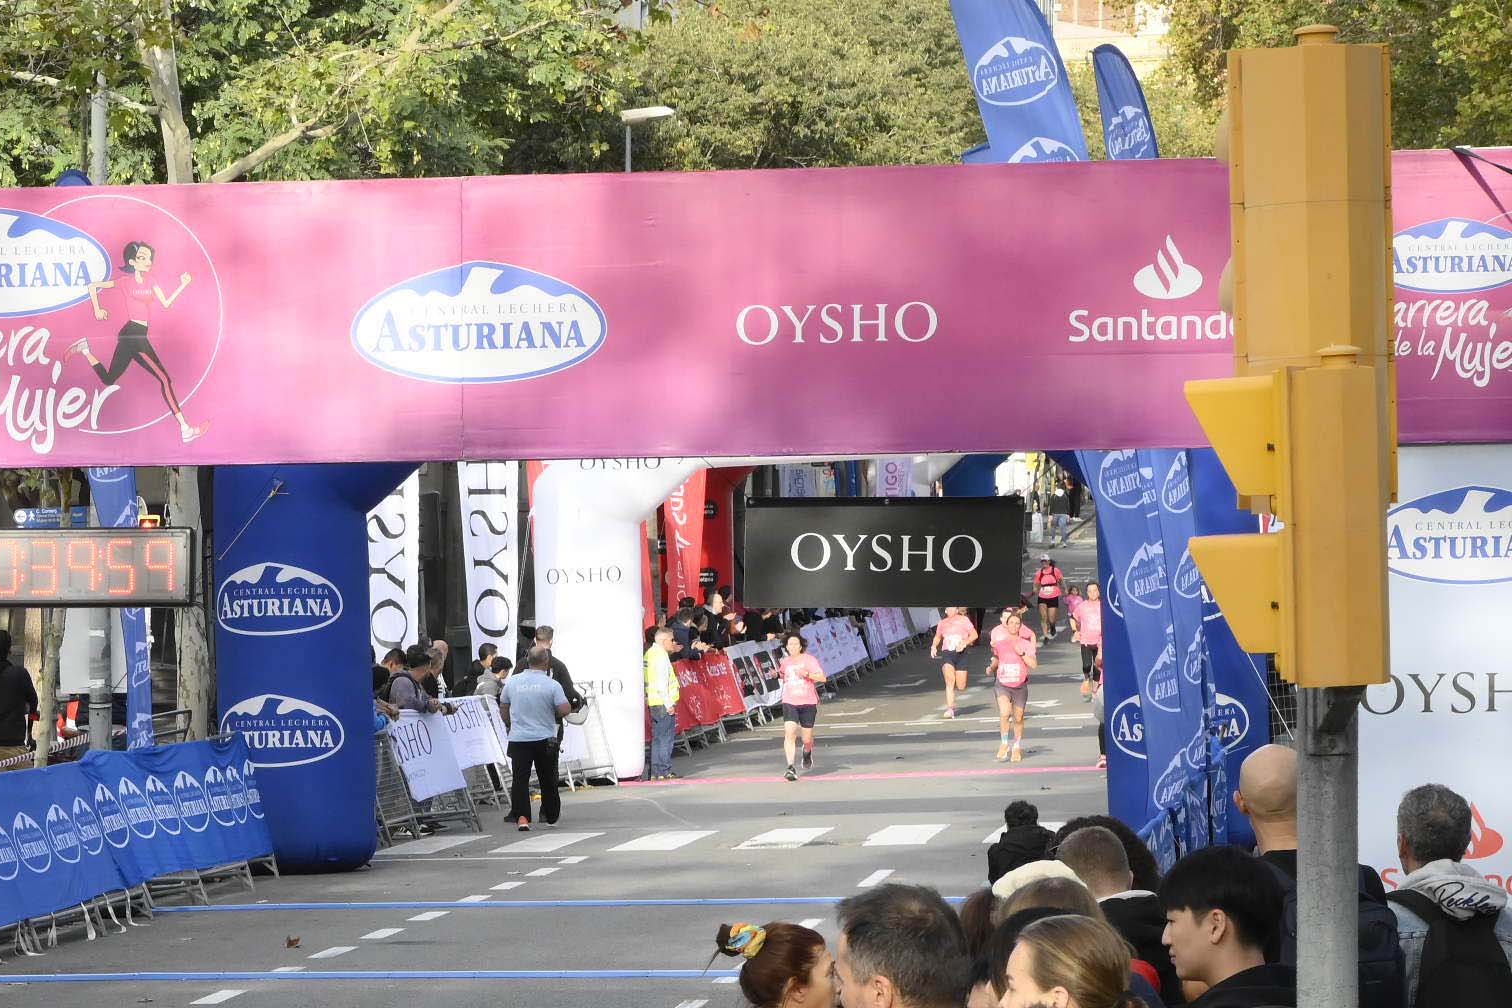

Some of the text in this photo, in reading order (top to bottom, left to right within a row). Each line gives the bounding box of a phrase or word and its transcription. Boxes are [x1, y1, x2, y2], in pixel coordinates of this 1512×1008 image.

[12, 244, 87, 256] LECHERA
[1408, 244, 1458, 252] CENTRAL
[410, 301, 578, 316] CENTRAL LECHERA
[373, 309, 587, 352] ASTURIANA
[735, 301, 938, 345] OYSHO
[1417, 329, 1435, 356] la
[1415, 519, 1482, 531] CENTRAL
[790, 532, 983, 573] OYSHO
[546, 565, 622, 585] OYSHO
[233, 587, 329, 596] CENTRAL LECHERA
[221, 592, 333, 619] ASTURIANA
[235, 718, 330, 728] CENTRAL LECHERA
[225, 723, 334, 749] TURIANA
